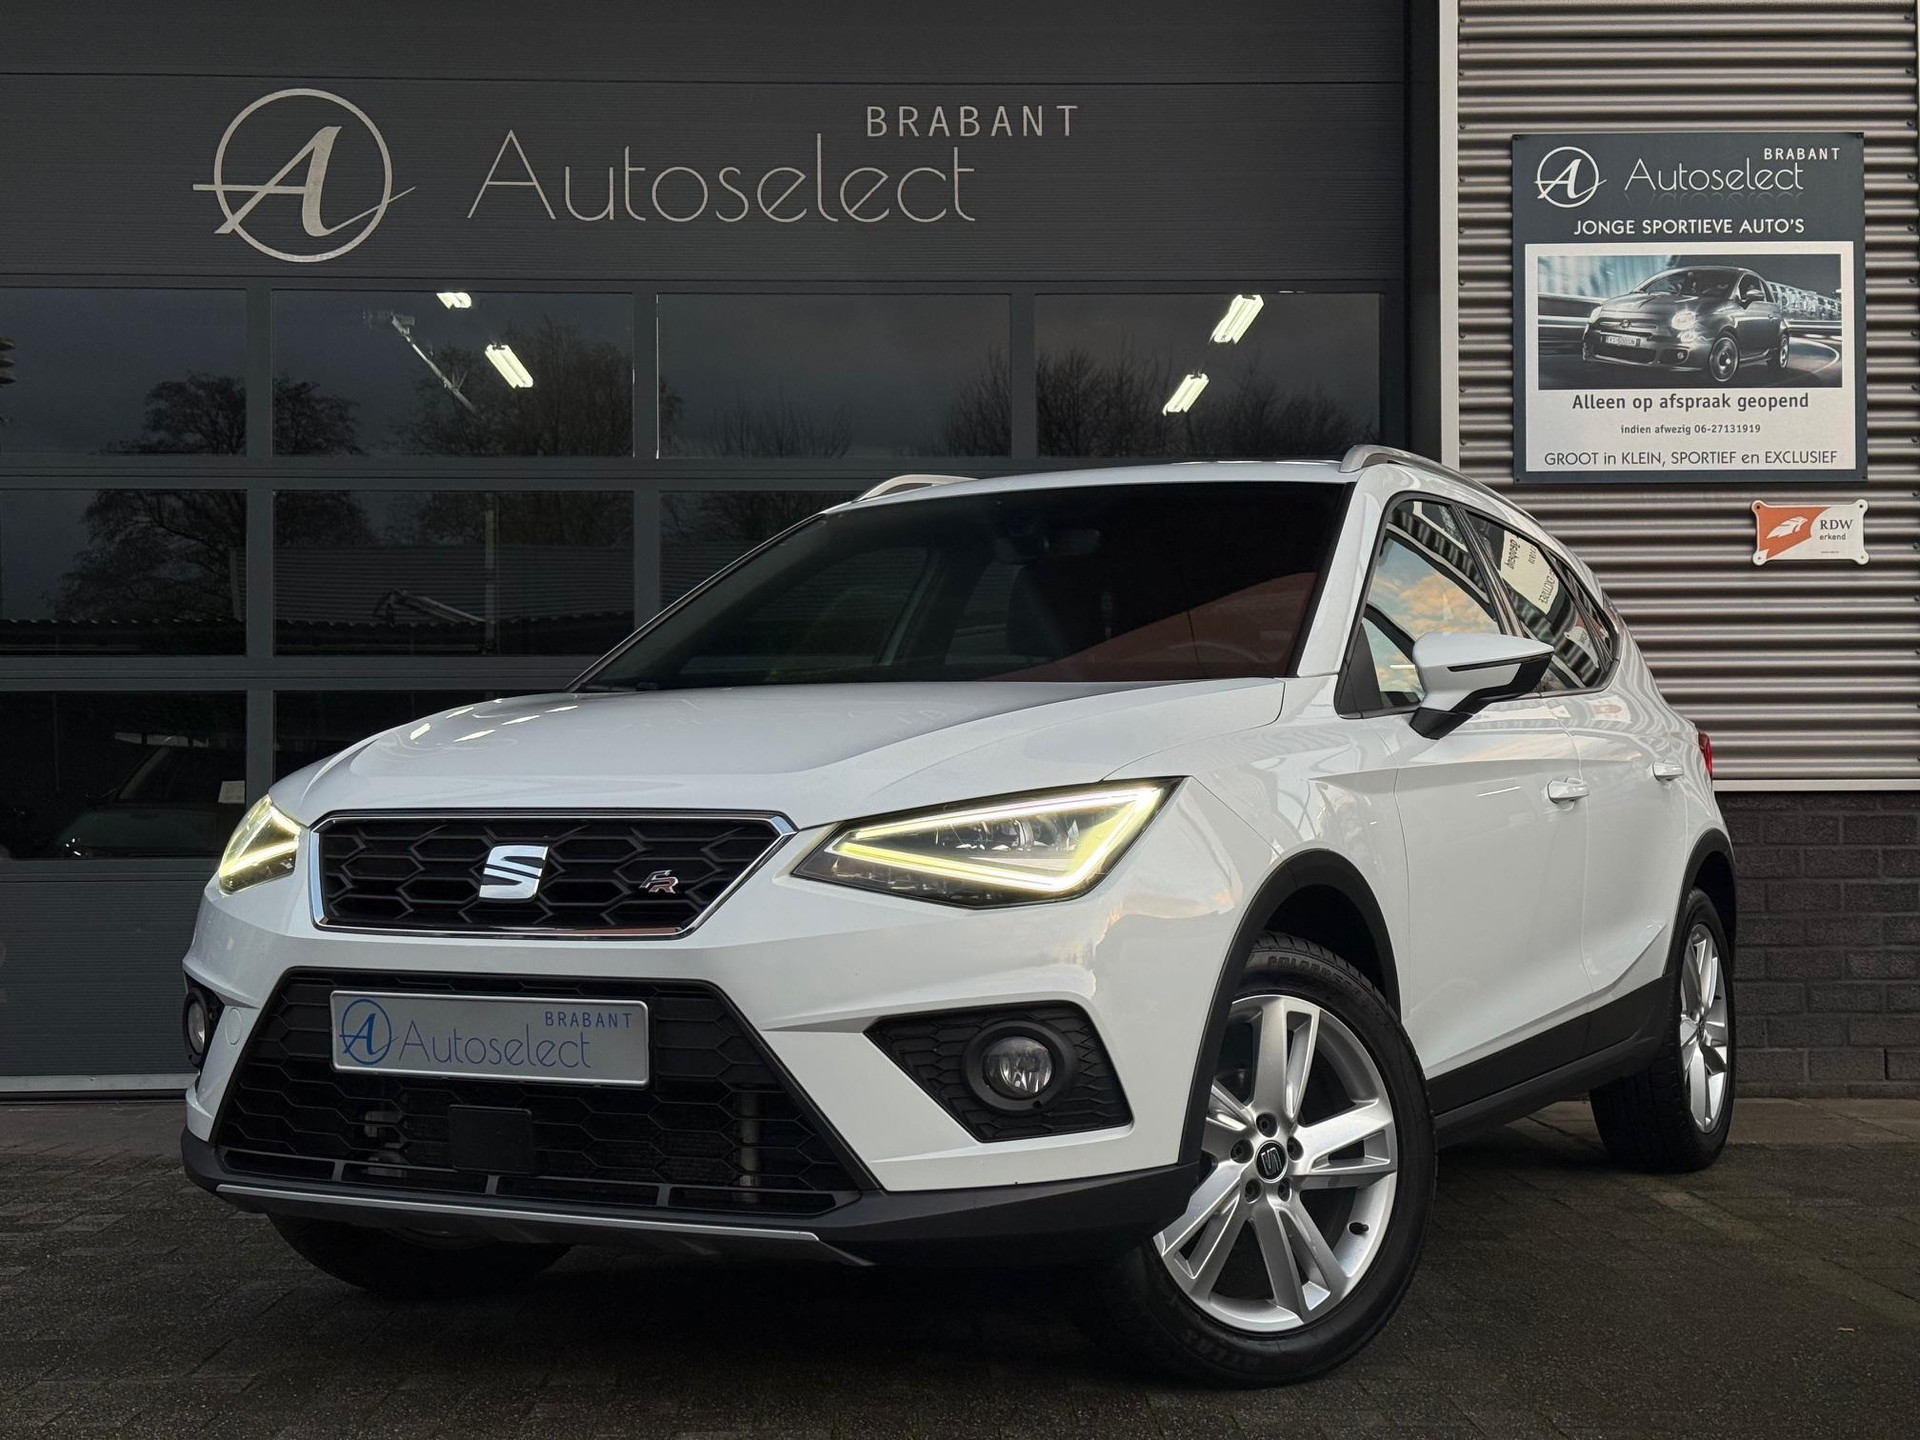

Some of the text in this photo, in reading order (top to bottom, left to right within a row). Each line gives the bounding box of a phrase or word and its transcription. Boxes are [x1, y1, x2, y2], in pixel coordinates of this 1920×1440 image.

[866, 104, 1079, 138] BRABANT
[1763, 147, 1841, 161] BRABANT
[466, 129, 976, 224] Autoselect
[1624, 157, 1804, 191] Autoselect
[1573, 218, 1806, 236] JONGE SPORTIEVE AUTO'S
[1571, 393, 1809, 412] Alleen op afspraak geopend
[1654, 424, 1691, 436] afwezig
[1694, 424, 1761, 434] 06-27131919
[1544, 450, 1838, 467] GROOT in KLEIN, SPORTIEF en EXCLUSIEF
[1819, 519, 1854, 531] RDW
[1819, 533, 1846, 541] erkend
[544, 1011, 633, 1030] BRABANT
[398, 1019, 592, 1069] Autoselect
